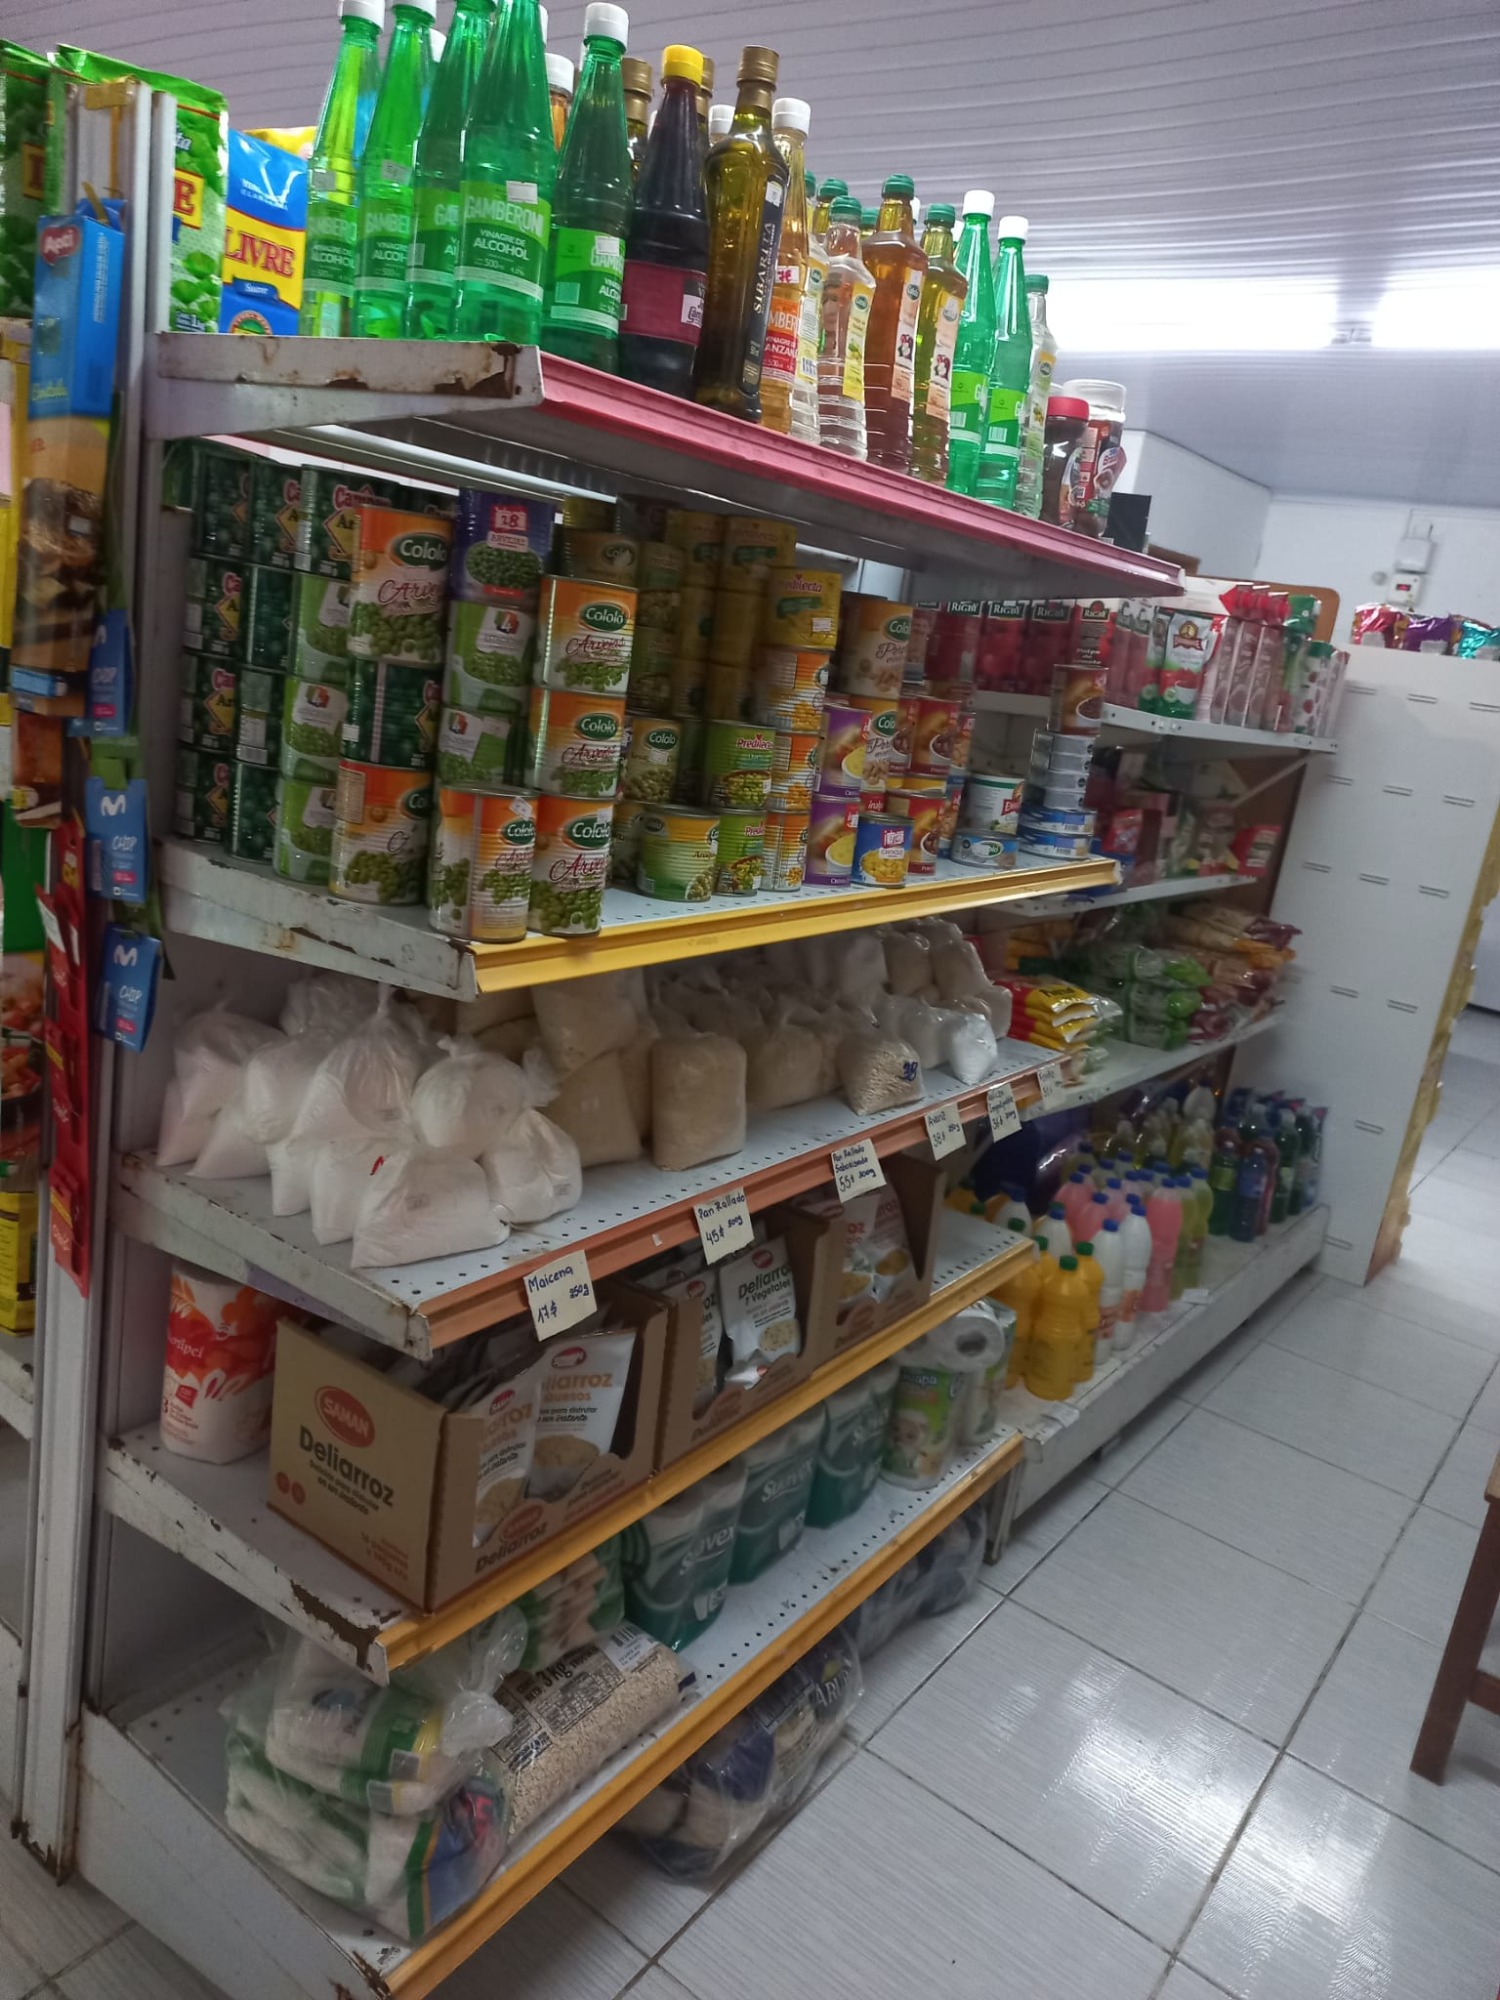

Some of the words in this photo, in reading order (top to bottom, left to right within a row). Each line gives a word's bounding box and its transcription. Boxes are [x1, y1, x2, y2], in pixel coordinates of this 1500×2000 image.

[472, 236, 531, 261] ALCOHOL
[697, 1207, 715, 1221] Pan
[528, 1266, 574, 1294] Maicena
[299, 1424, 396, 1508] Deliarroz
